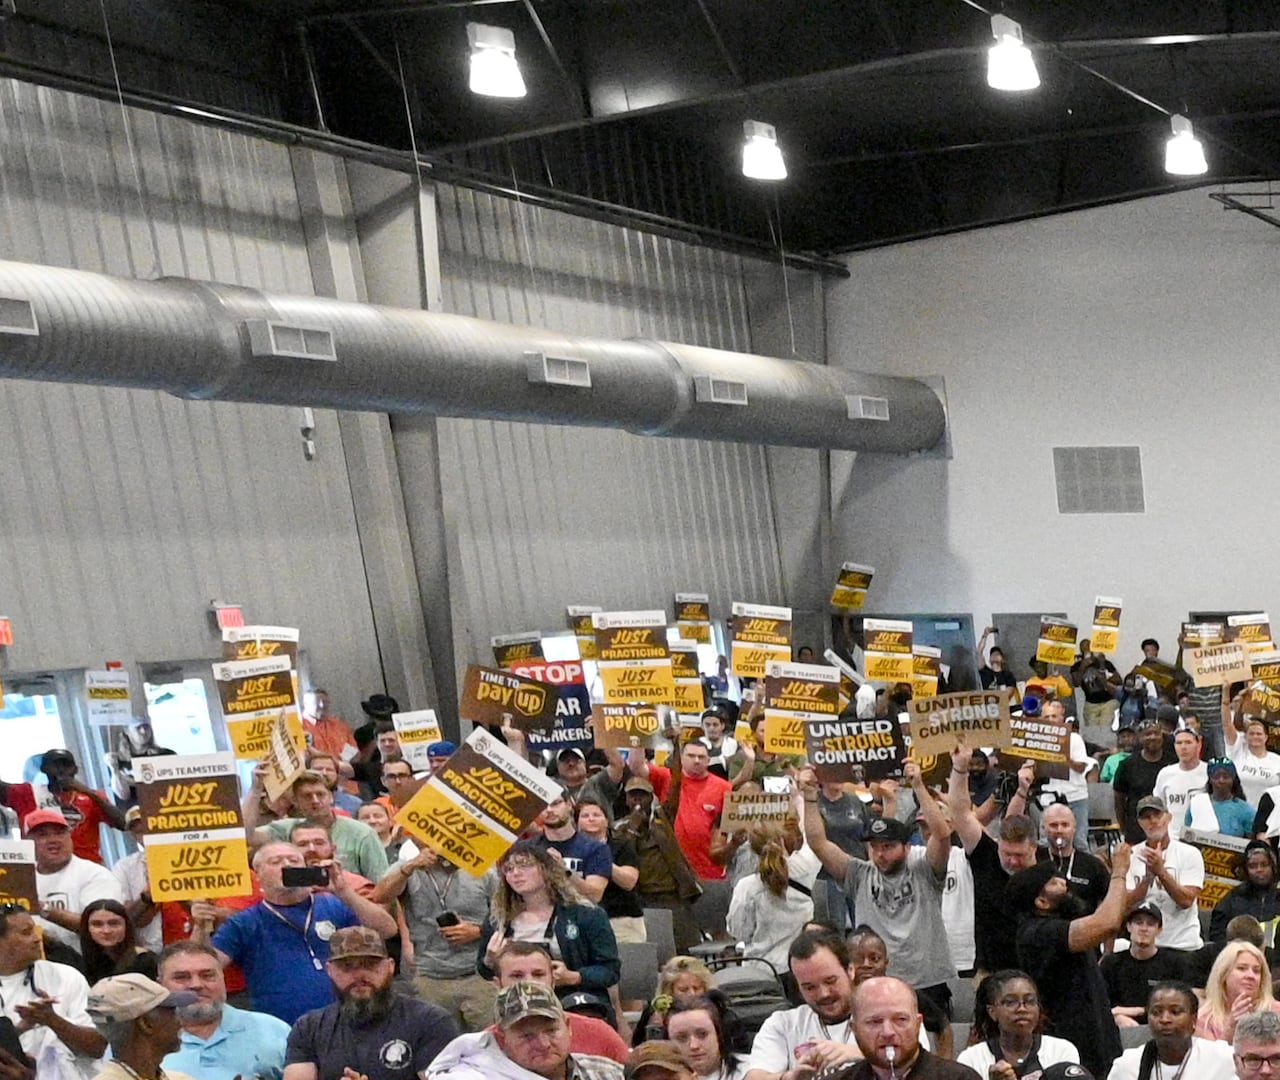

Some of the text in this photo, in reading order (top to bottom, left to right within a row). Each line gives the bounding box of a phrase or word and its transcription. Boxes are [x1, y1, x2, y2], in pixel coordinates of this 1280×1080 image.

[745, 619, 778, 630] JUST
[611, 629, 652, 644] JUST
[874, 632, 902, 643] JUST
[602, 648, 666, 659] PRACTICING
[744, 650, 776, 662] JUST
[1194, 645, 1243, 658] UNITED
[513, 664, 581, 682] STOP
[618, 670, 656, 682] JUST
[868, 671, 909, 679] CONTRACT
[1197, 662, 1246, 674] CONTRACT
[237, 677, 275, 695] JUST
[480, 671, 520, 687] TIME TO
[477, 681, 540, 711] pay up
[608, 688, 669, 698] CONTRACT
[781, 681, 824, 695] JUST
[228, 694, 291, 711] PRACTICING
[770, 698, 835, 712] PRACTICING
[916, 695, 1000, 714] UNITED
[602, 707, 636, 715] TIME TO
[929, 704, 999, 726] STRONG
[604, 715, 658, 731] pay up
[809, 720, 893, 738] UNITED
[920, 720, 1001, 739] CONTRACT
[824, 733, 894, 751] STRONG
[815, 747, 896, 764] CONTRACT
[1242, 765, 1258, 776] pay
[470, 766, 527, 801] JUST
[160, 782, 218, 806] JUST
[443, 769, 522, 830] PRACTICING
[730, 794, 790, 803] UNITED
[1169, 793, 1186, 805] pay
[728, 812, 788, 821] CONTRACT
[738, 802, 788, 815] STRONG
[148, 811, 237, 830] PRACTICING
[433, 807, 488, 839] JUST
[407, 811, 485, 868] CONTRACT
[171, 846, 226, 868] JUST
[159, 873, 243, 892] CONTRACT
